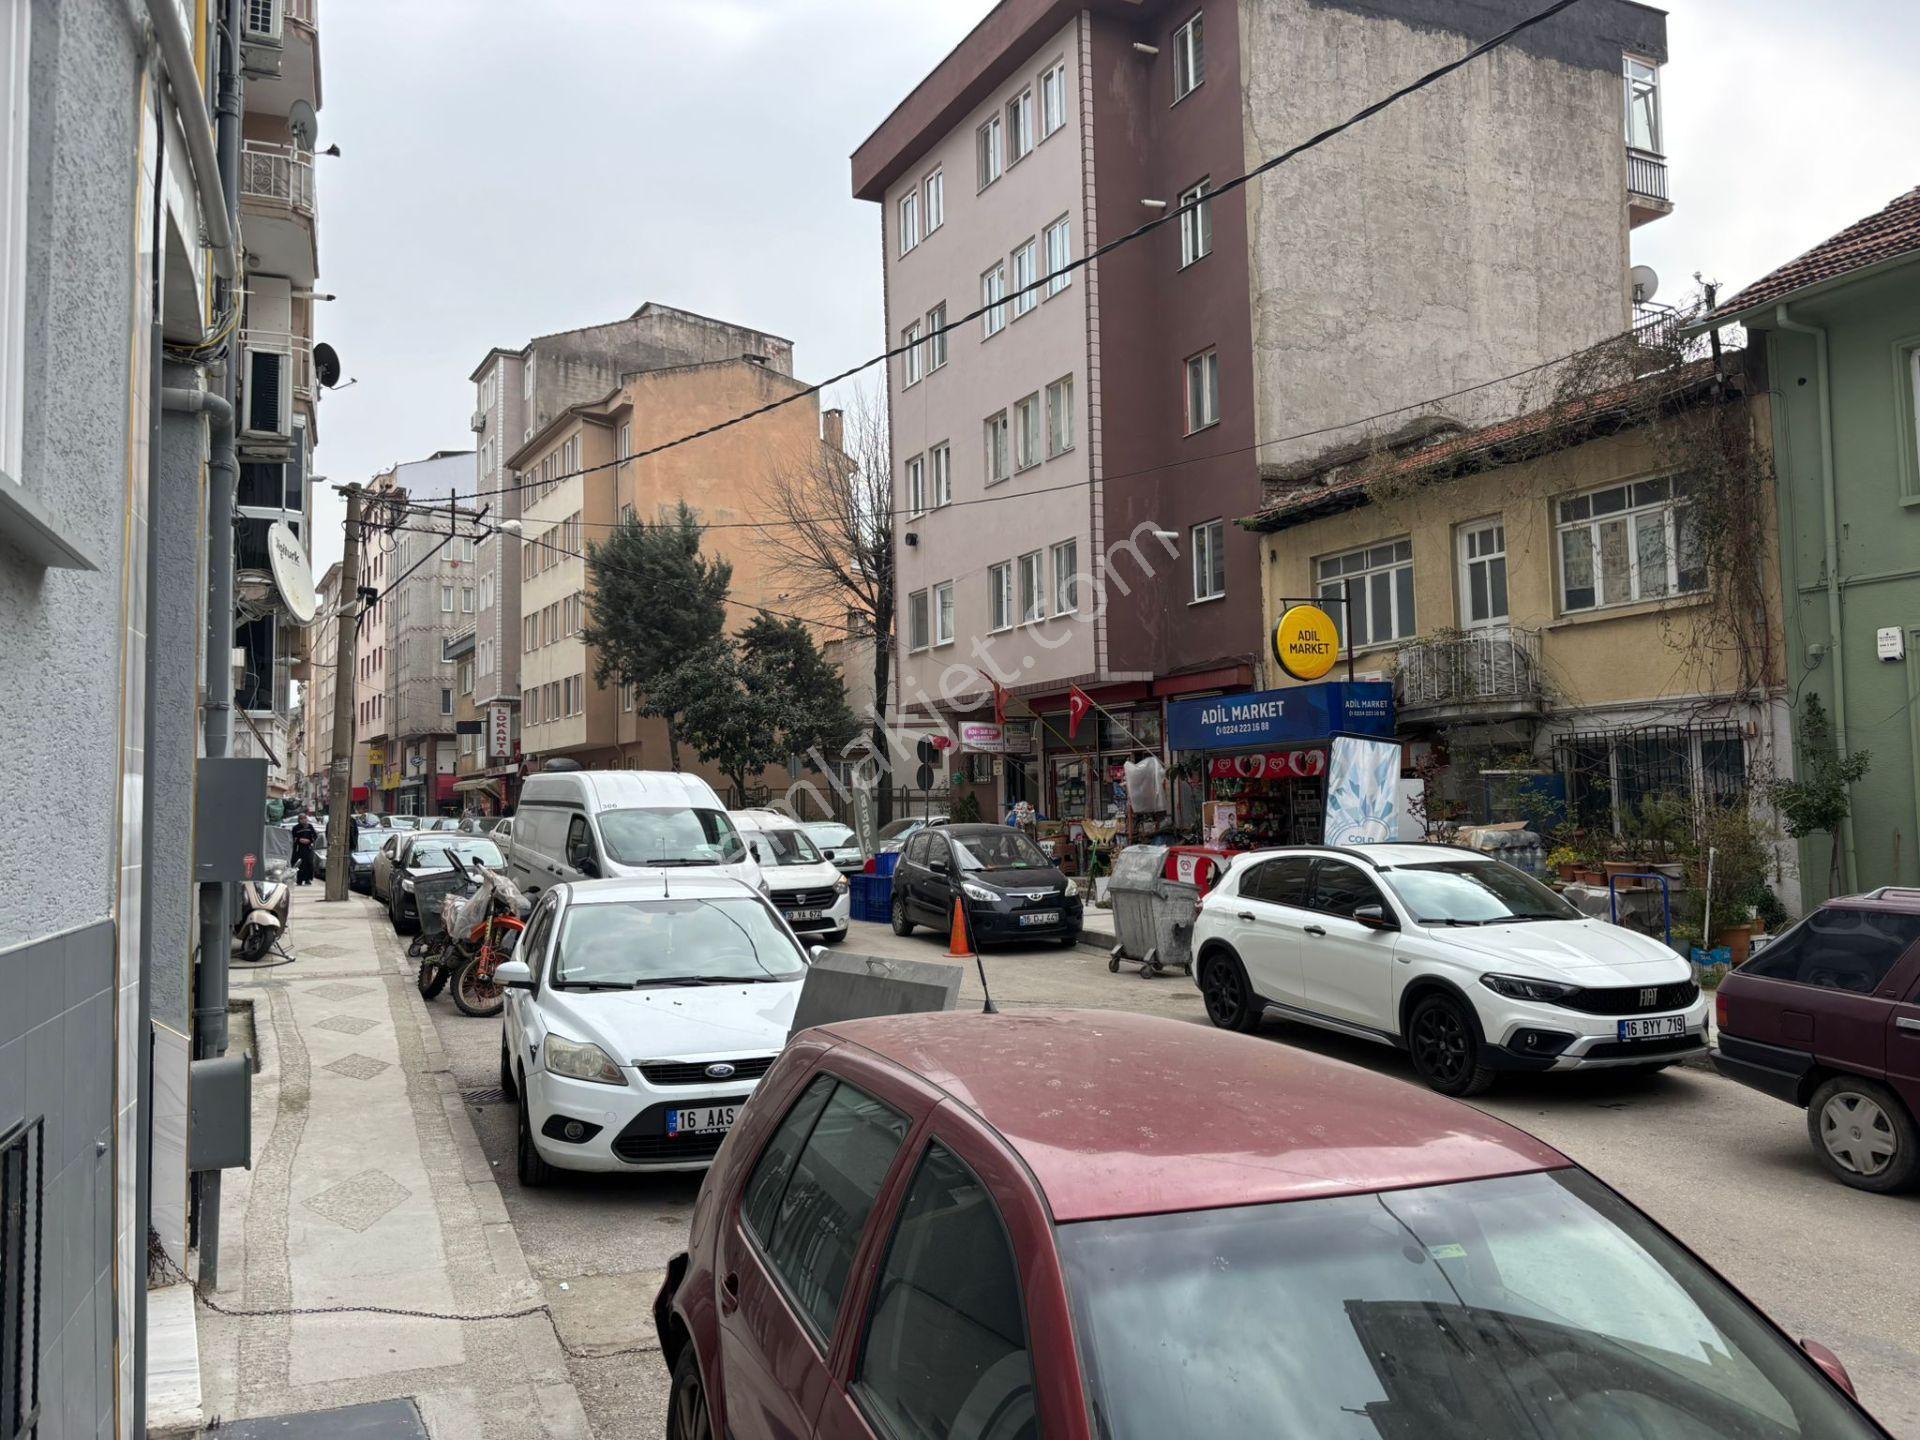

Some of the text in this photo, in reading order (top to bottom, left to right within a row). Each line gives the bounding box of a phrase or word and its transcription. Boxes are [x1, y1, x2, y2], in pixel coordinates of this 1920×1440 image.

[1298, 628, 1320, 642] ADİL
[1289, 643, 1330, 655] MARKET
[1201, 700, 1285, 725] ADİL MARKET
[1361, 700, 1388, 708] MARKET
[496, 709, 507, 756] LOKANTA
[1639, 988, 1658, 1006] FIAT
[1626, 1017, 1683, 1036] 16 BYY 719
[680, 1107, 734, 1129] 16 AAS
